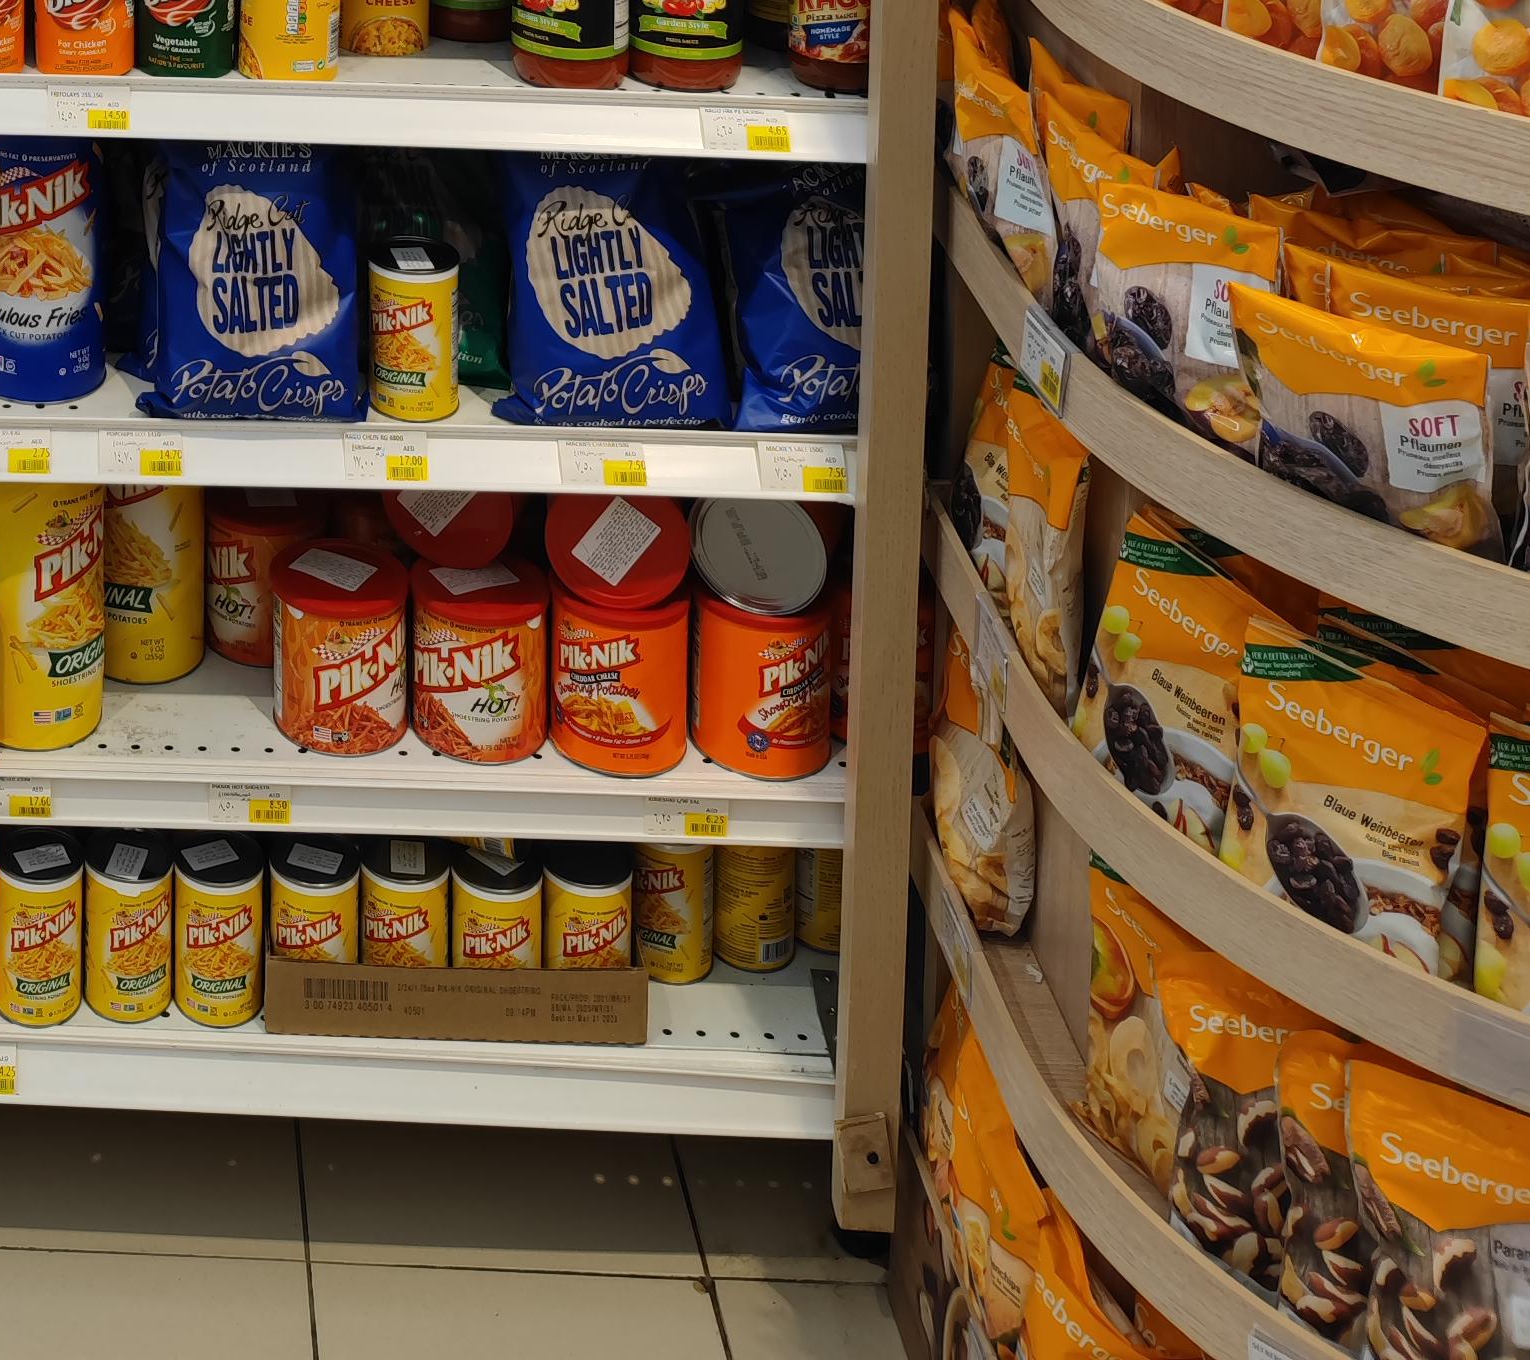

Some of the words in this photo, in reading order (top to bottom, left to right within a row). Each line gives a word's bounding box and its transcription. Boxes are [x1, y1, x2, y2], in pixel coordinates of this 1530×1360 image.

[656, 17, 687, 28] Garden
[689, 21, 710, 29] Style
[806, 13, 833, 22] Pizza
[810, 25, 851, 35] HOMEMADE
[819, 32, 840, 40] STYLE
[58, 39, 70, 48] For
[74, 39, 107, 48] Chicken
[154, 34, 198, 48] Vegetable
[103, 111, 127, 120] 14.50
[1102, 193, 1217, 245] Seeberger
[552, 227, 643, 278] LIGHTLY
[562, 274, 652, 336] SALTED
[1350, 292, 1518, 348] Seeberger
[1258, 314, 1406, 385] Seeberger
[171, 361, 255, 409] Potato
[258, 369, 347, 413] Crisps
[1409, 415, 1458, 438] SOFT
[1400, 436, 1462, 453] Pflaumen
[32, 448, 50, 458] 2.75
[399, 455, 423, 465] 17.00
[1134, 568, 1238, 657] Seeberger
[472, 696, 518, 715] HOT!
[1266, 681, 1414, 771] Seeberger
[1324, 793, 1357, 820] Blaue
[1360, 812, 1425, 849] Weinbeeren
[17, 979, 68, 994] ORIGINAL
[328, 1002, 353, 1010] 74923
[0, 1066, 16, 1077] 4.25
